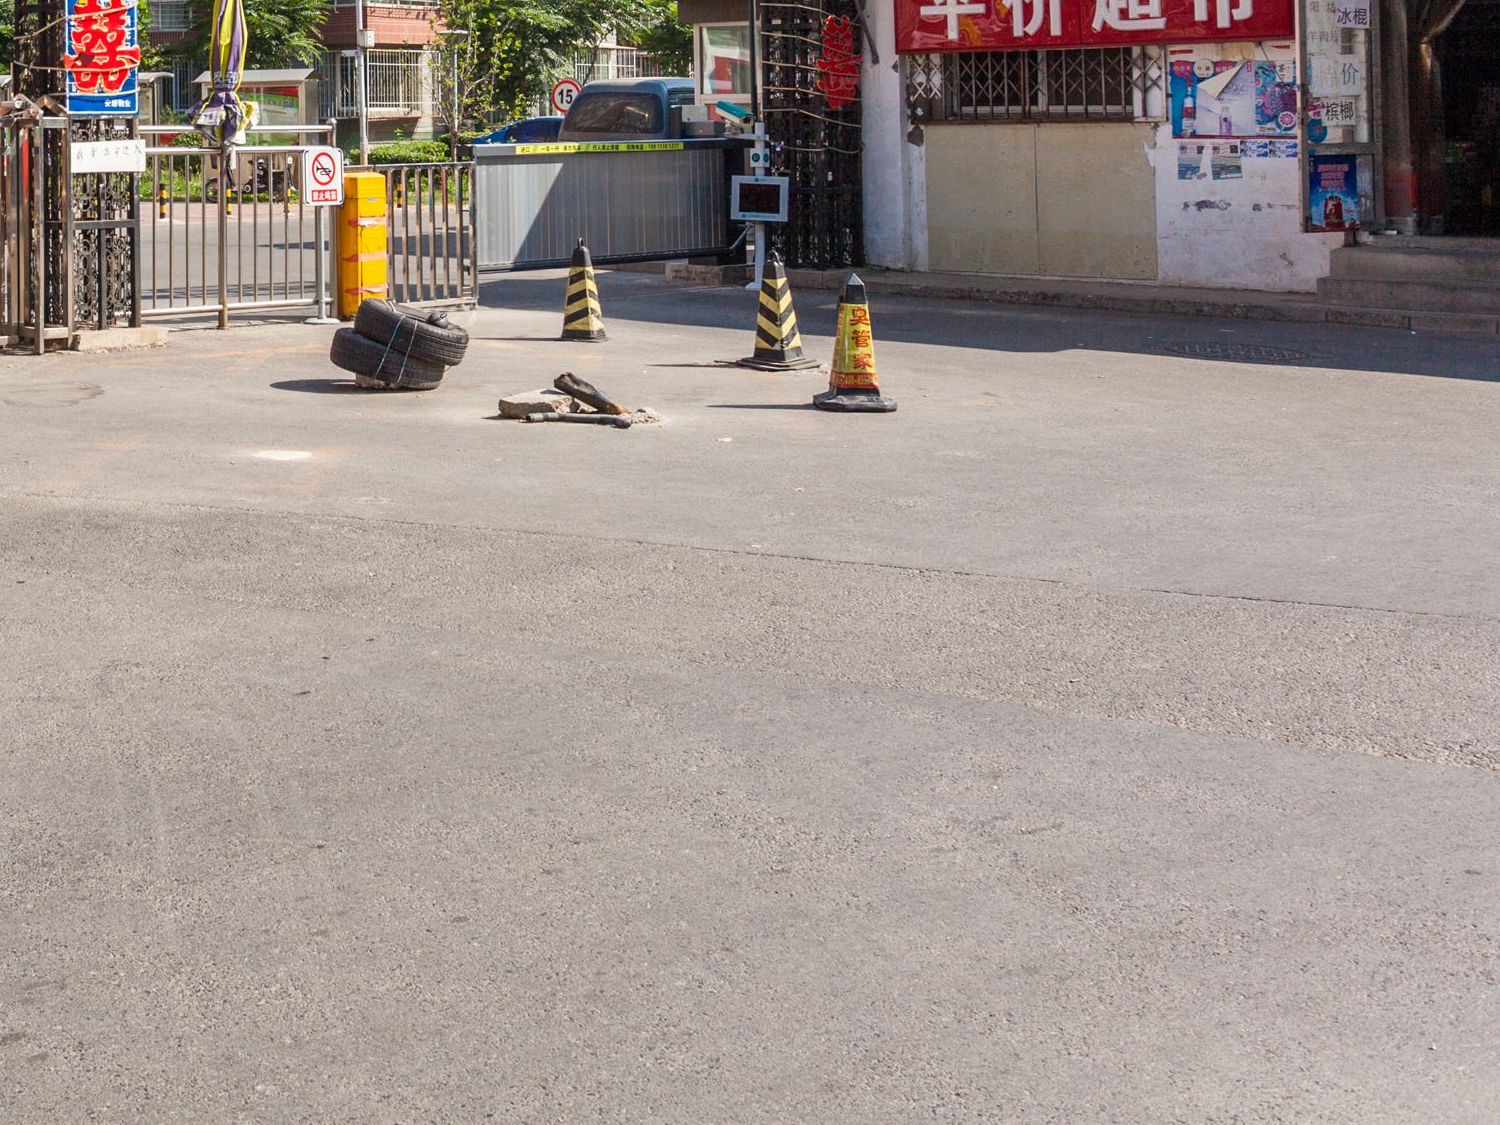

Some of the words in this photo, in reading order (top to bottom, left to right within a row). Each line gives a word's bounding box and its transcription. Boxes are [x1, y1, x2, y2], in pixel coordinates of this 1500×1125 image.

[1337, 7, 1368, 26] 冰棍
[558, 89, 573, 105] 15
[1325, 101, 1354, 121] 槟榔
[313, 190, 337, 201] 禁止鸣笛
